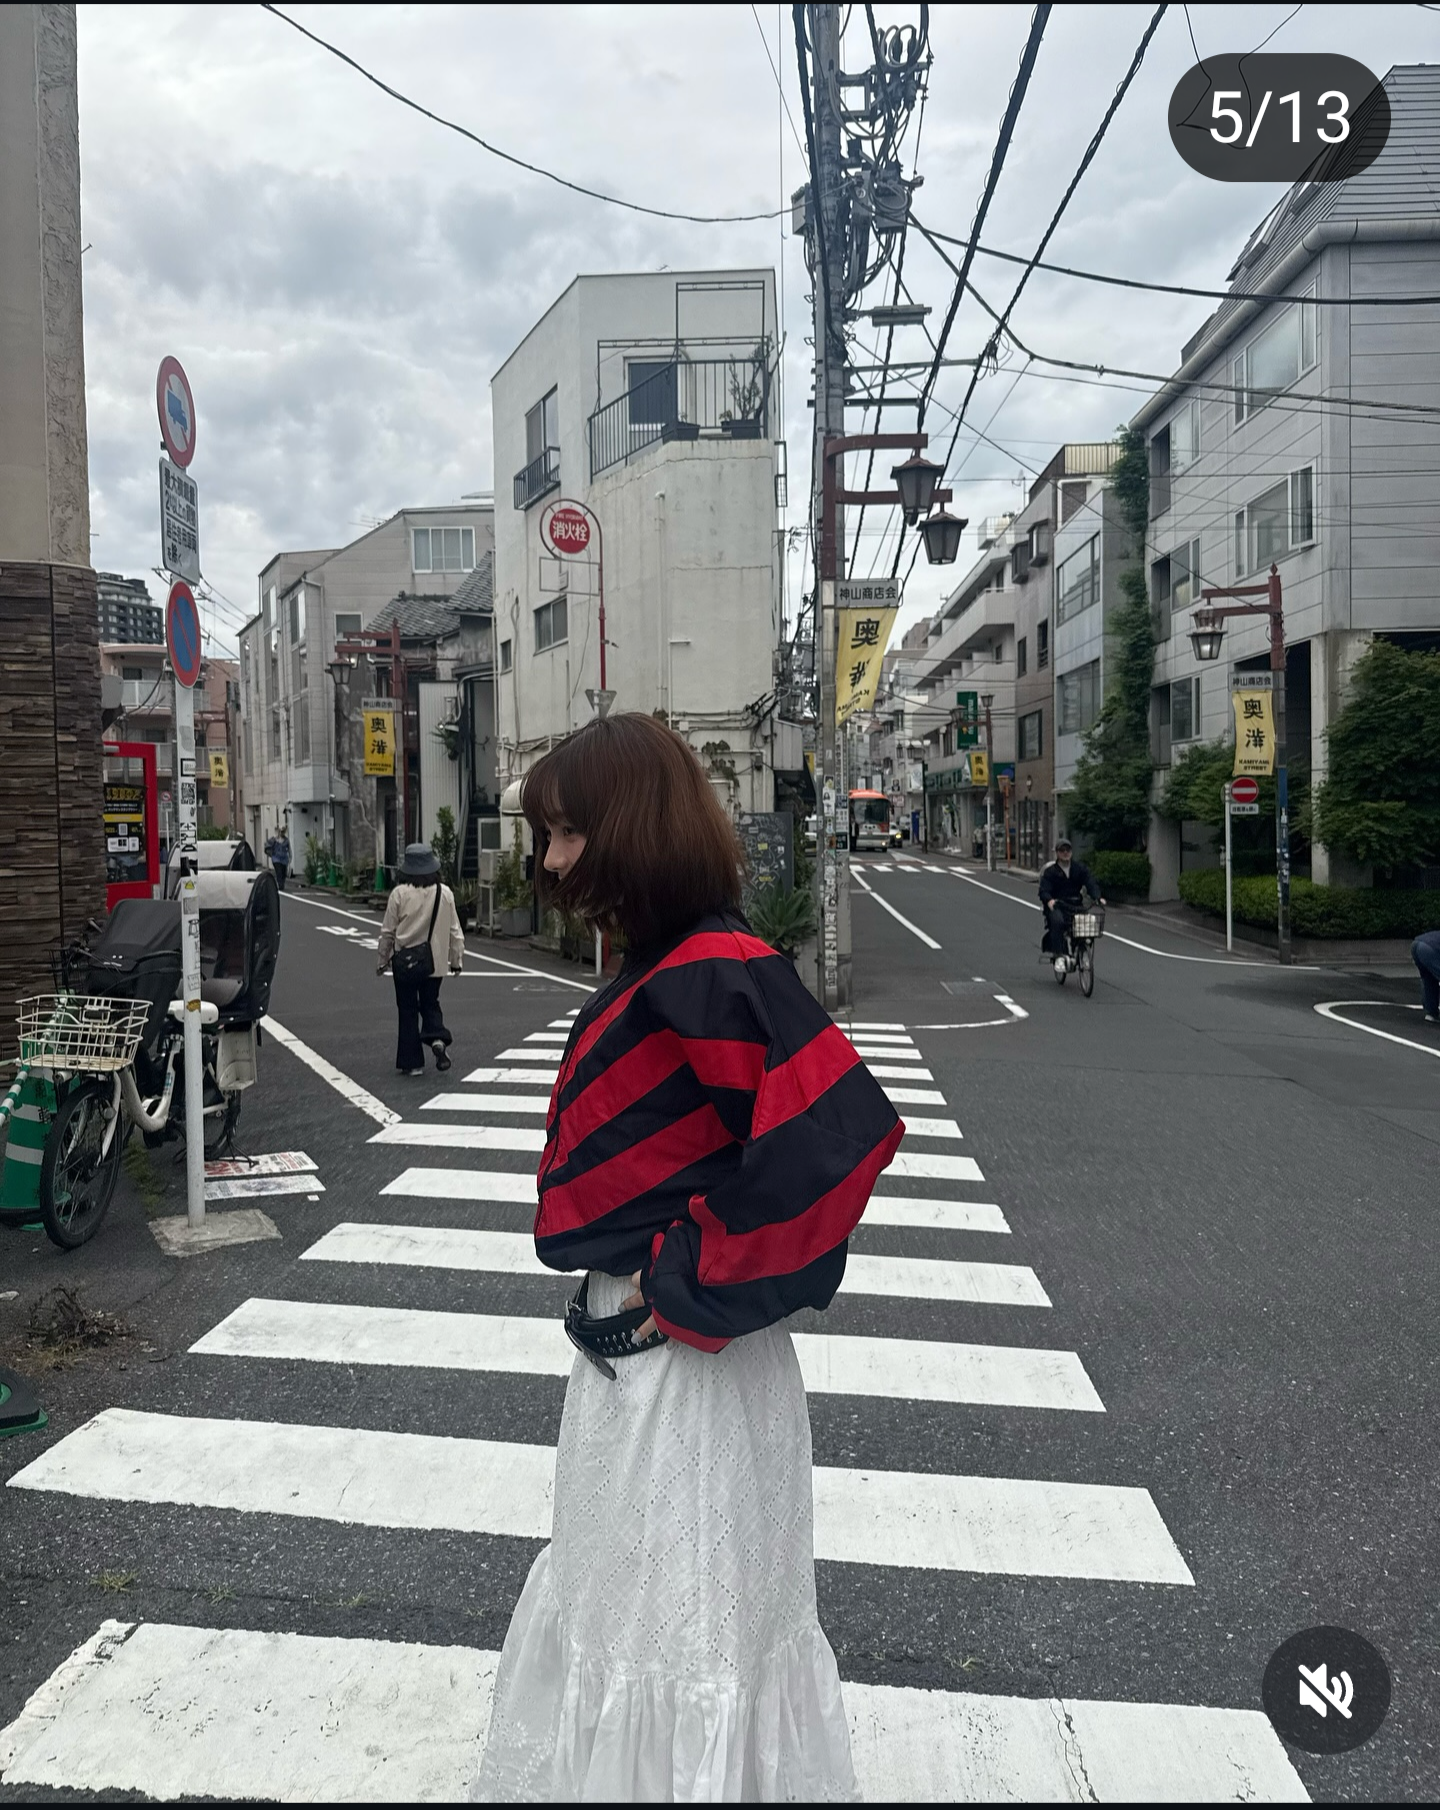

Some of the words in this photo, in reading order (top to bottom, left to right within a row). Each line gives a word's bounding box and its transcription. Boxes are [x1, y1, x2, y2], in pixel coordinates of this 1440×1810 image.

[552, 520, 588, 542] 消火栓
[839, 586, 897, 600] 神山商店会
[1232, 676, 1271, 686] 神山商店会
